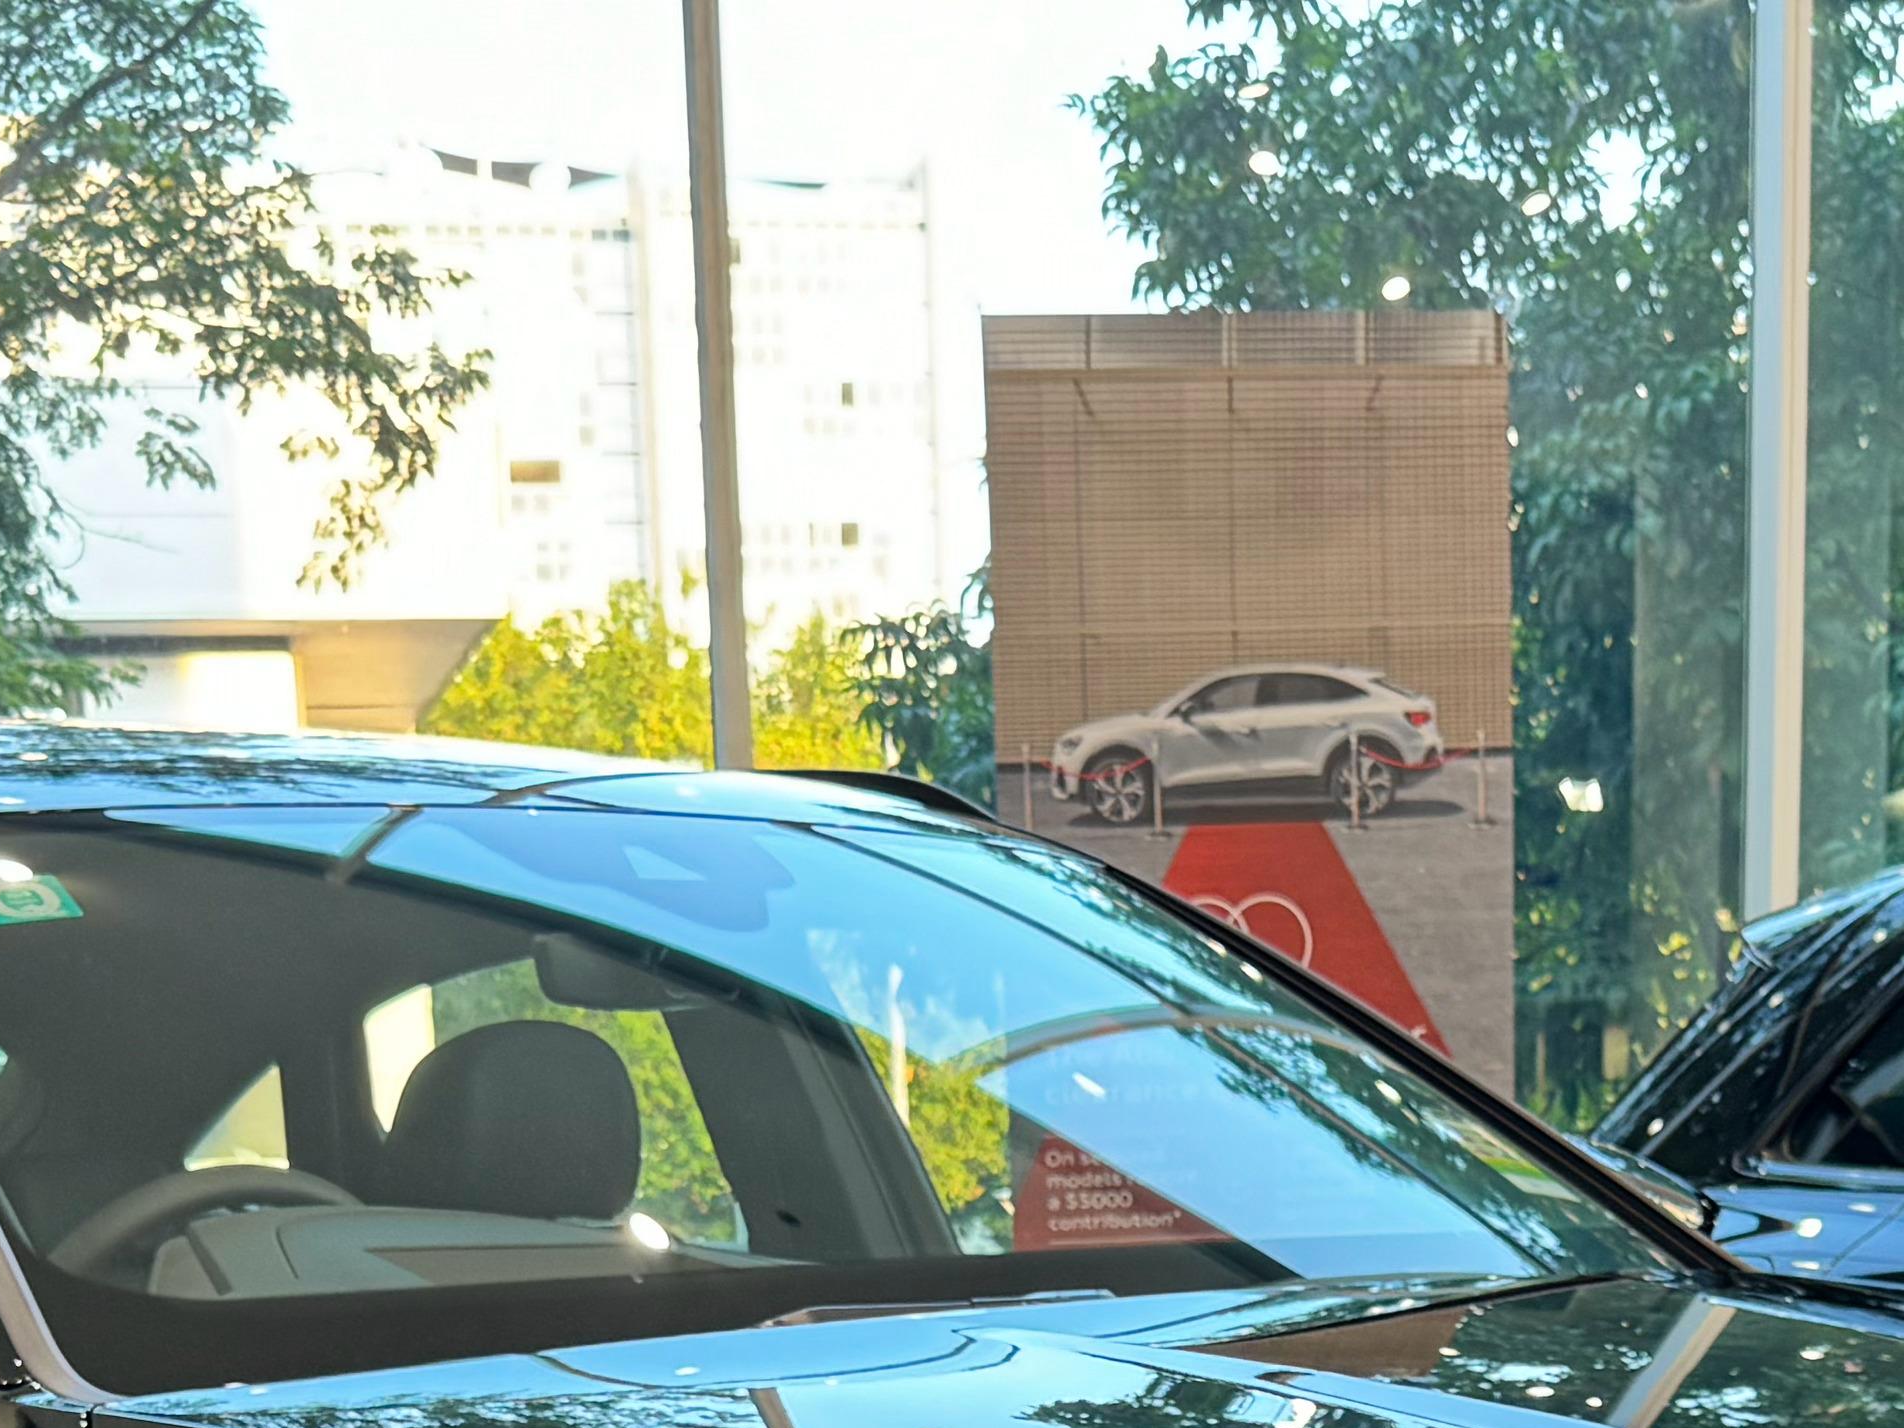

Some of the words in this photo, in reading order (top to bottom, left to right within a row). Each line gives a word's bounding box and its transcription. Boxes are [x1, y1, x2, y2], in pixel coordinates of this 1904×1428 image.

[1044, 1148, 1075, 1168] On
[1046, 1172, 1122, 1190] models
[1066, 1191, 1133, 1211] $5000
